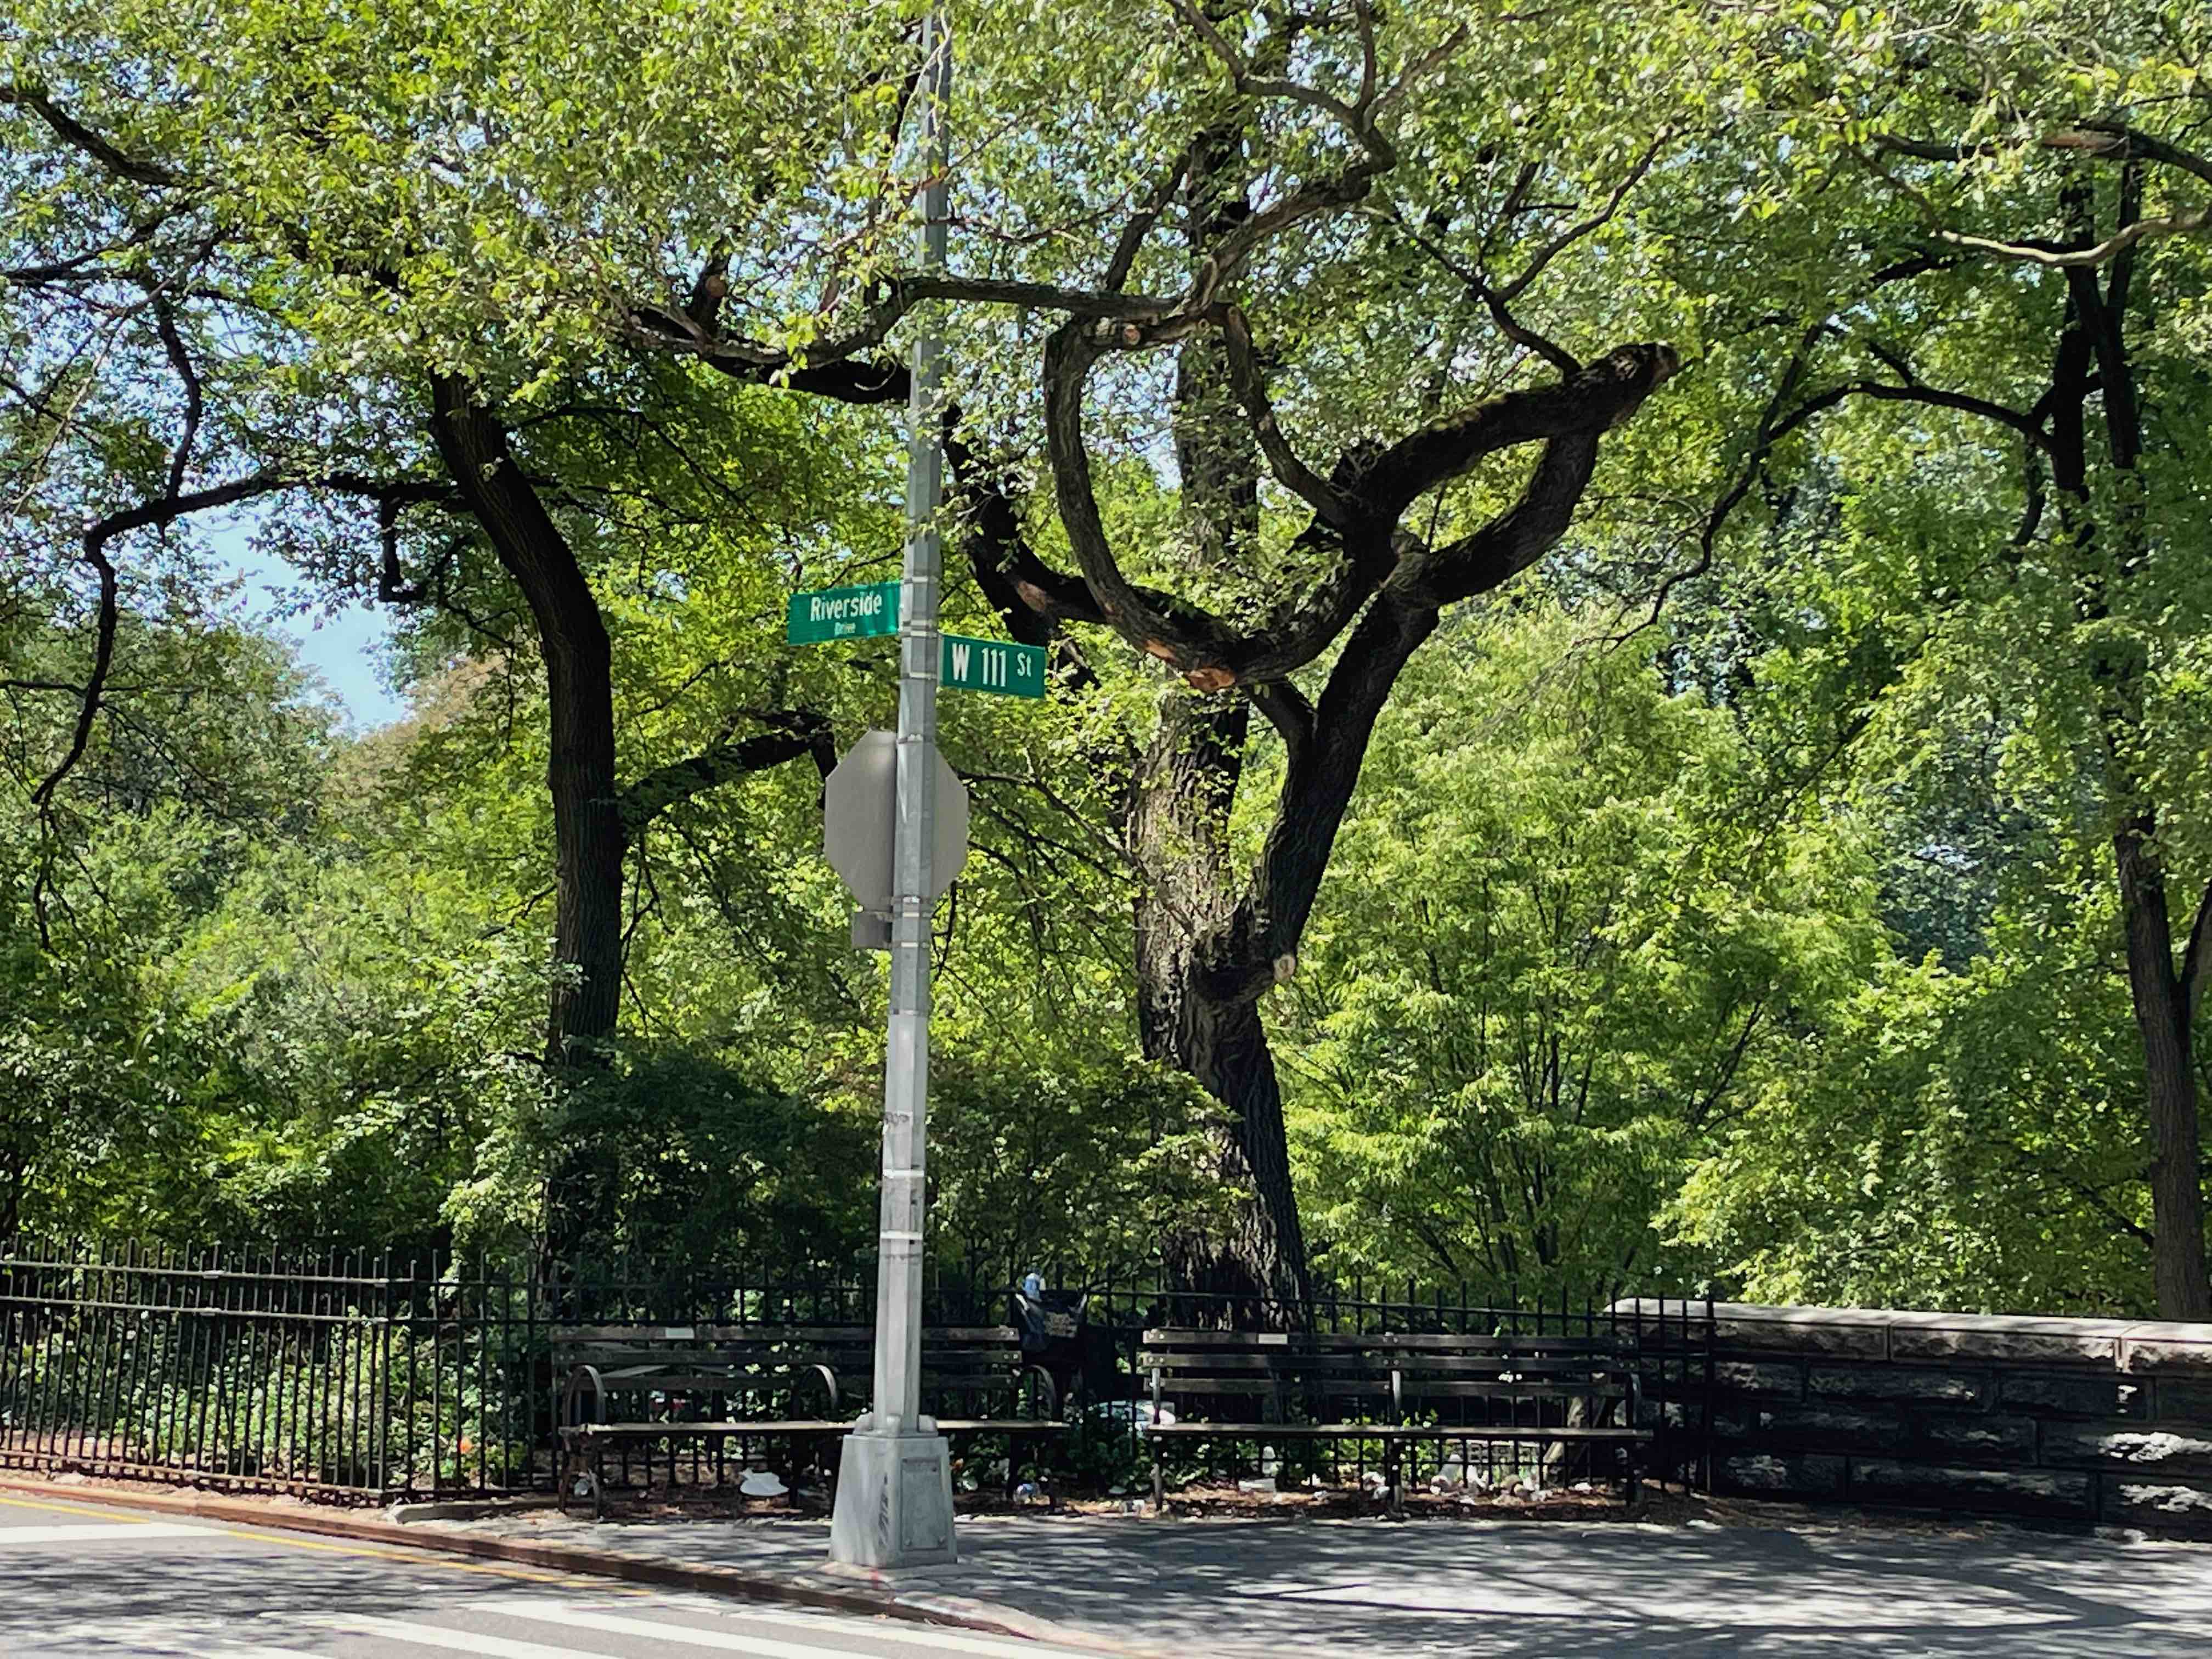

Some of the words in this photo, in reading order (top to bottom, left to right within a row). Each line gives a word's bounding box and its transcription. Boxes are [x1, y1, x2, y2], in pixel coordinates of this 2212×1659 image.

[810, 590, 882, 622] Riverside
[952, 642, 970, 682] W
[981, 647, 1006, 687] 111
[1017, 652, 1031, 677] St
